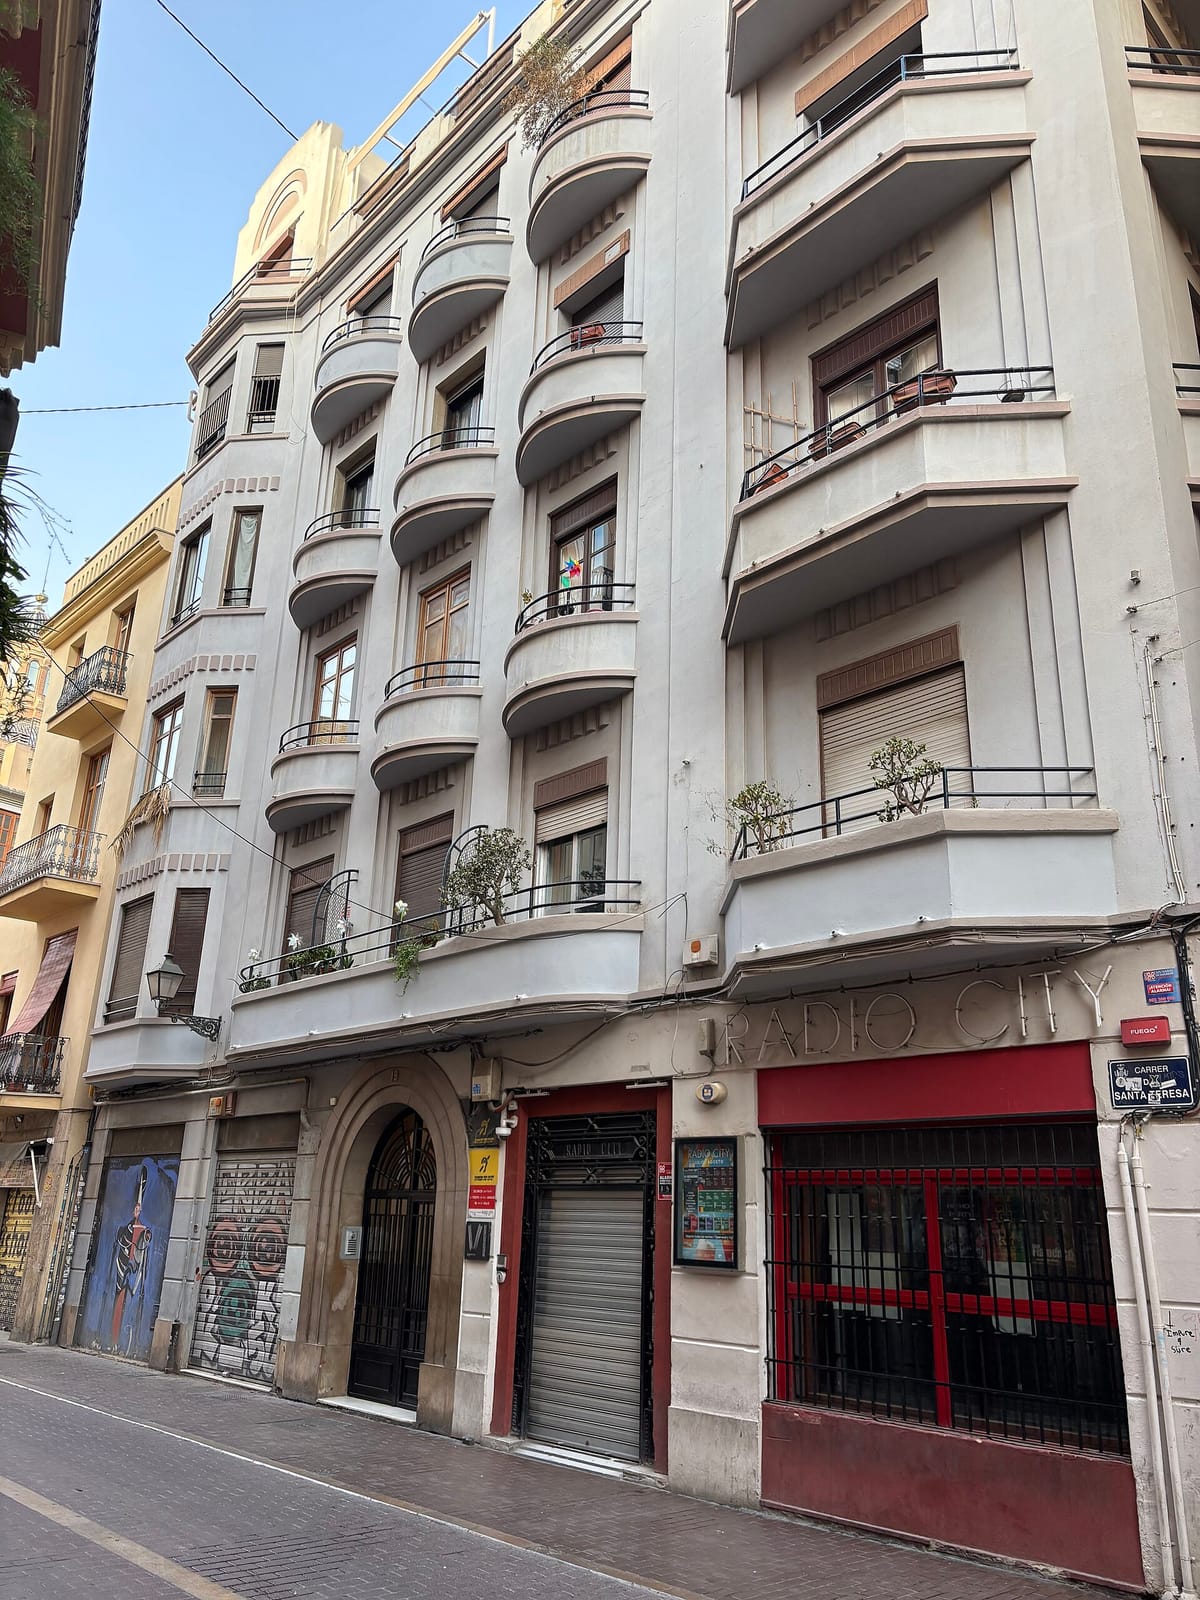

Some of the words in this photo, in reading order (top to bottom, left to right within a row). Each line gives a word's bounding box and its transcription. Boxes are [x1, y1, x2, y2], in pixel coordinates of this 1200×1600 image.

[725, 993, 917, 1065] RADIO
[955, 965, 1113, 1043] CITY
[1130, 1027, 1156, 1035] FUEGO
[1134, 1065, 1169, 1074] CARRER
[1114, 1091, 1147, 1100] SANTA
